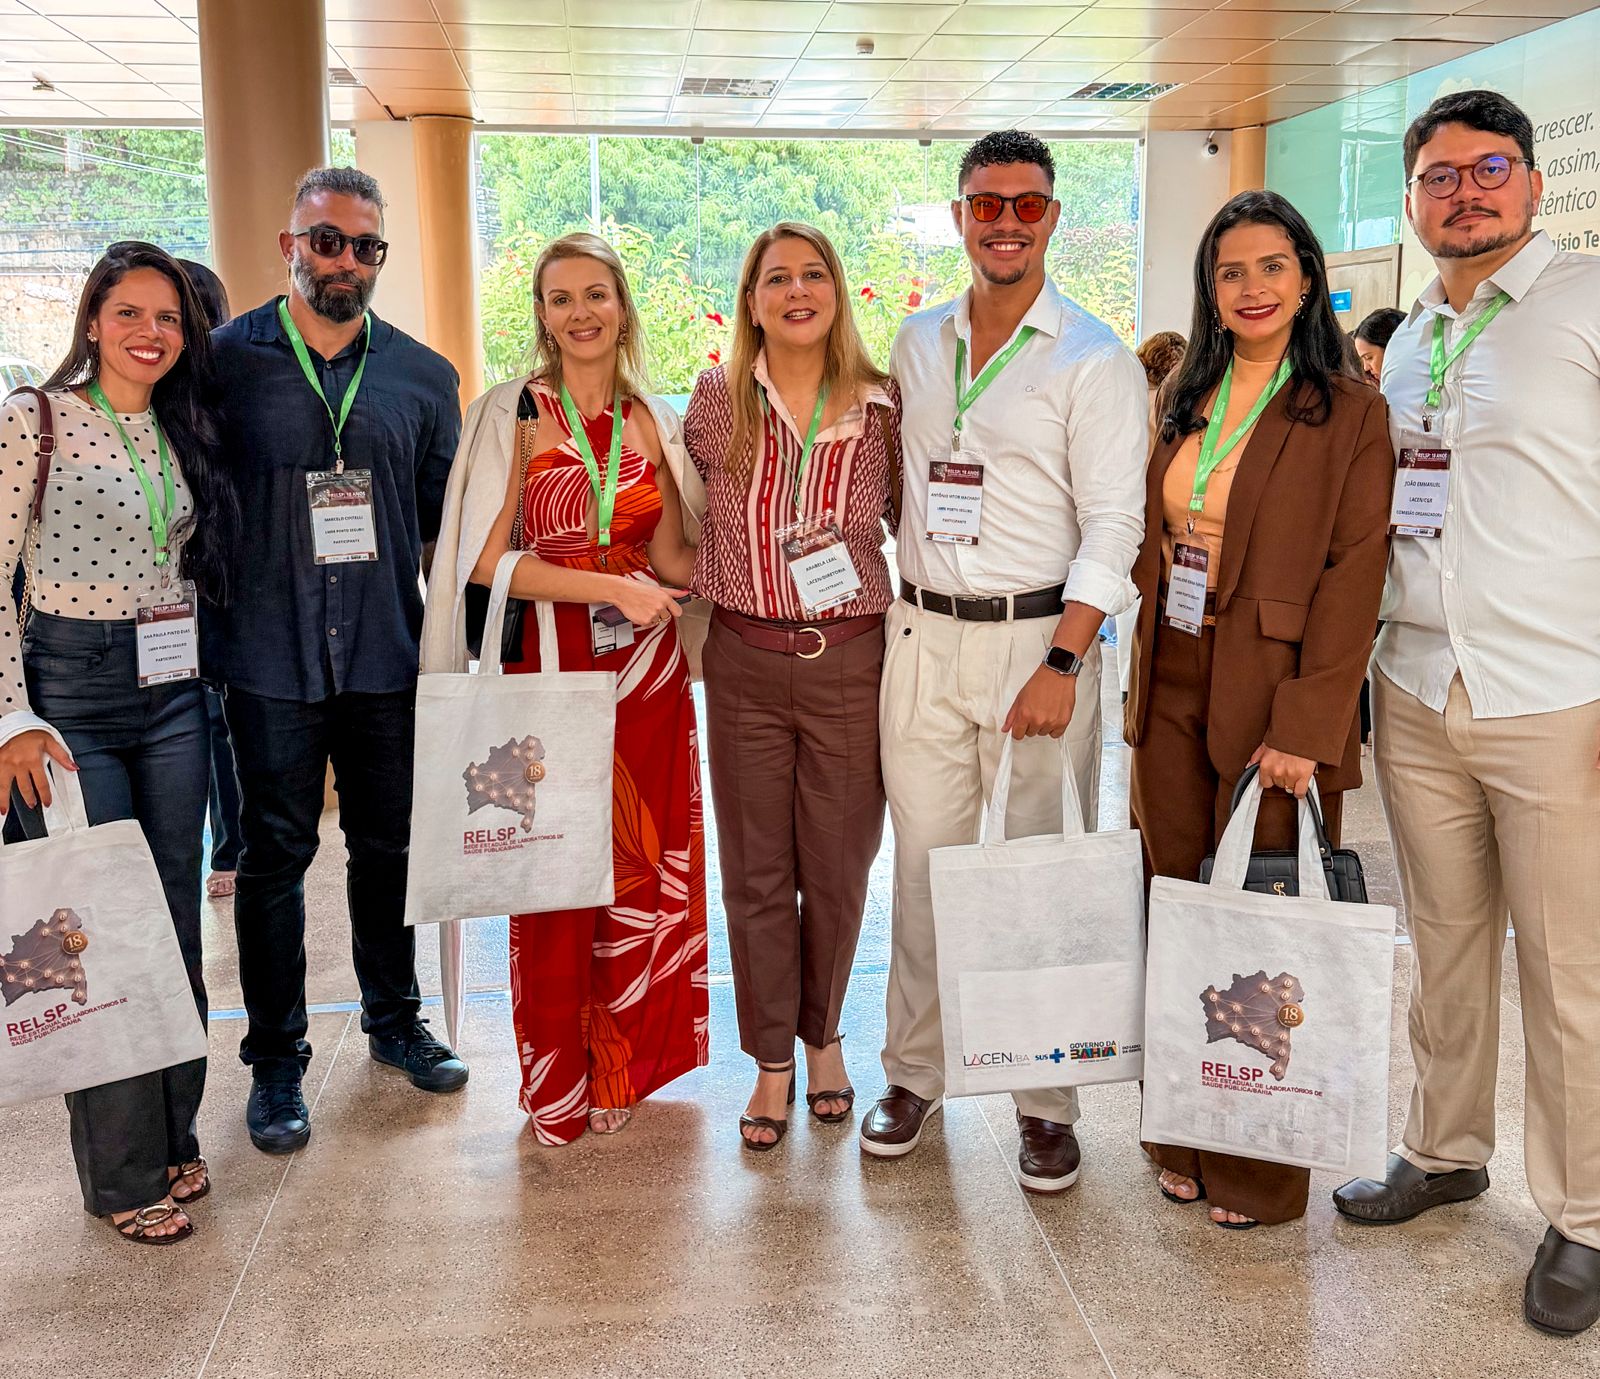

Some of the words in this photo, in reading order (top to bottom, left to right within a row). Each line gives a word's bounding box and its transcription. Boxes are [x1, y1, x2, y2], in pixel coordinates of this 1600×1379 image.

[1534, 112, 1594, 143] crescer.
[1539, 187, 1597, 216] têntico
[1552, 232, 1580, 251] ísio
[1584, 230, 1599, 248] Te
[530, 764, 541, 777] 18
[464, 827, 516, 844] RELSP
[480, 840, 508, 849] ESTADUAL
[66, 935, 83, 949] 18
[6, 1003, 68, 1036] RELSP
[9, 1034, 28, 1042] REDE
[29, 1020, 61, 1038] ESTADUAL
[62, 1014, 71, 1022] DE
[73, 999, 119, 1018] LABORATÓRIOS
[1283, 1007, 1298, 1020] 18
[1070, 1047, 1117, 1060] BAHIA
[1201, 1061, 1263, 1082] RELSP
[1202, 1075, 1219, 1083] REDE
[1220, 1077, 1254, 1088] ESTADUAL
[1265, 1084, 1313, 1095] LABORATÓRIOS
[1224, 1084, 1273, 1096] PÚBLICA/BAHIA
